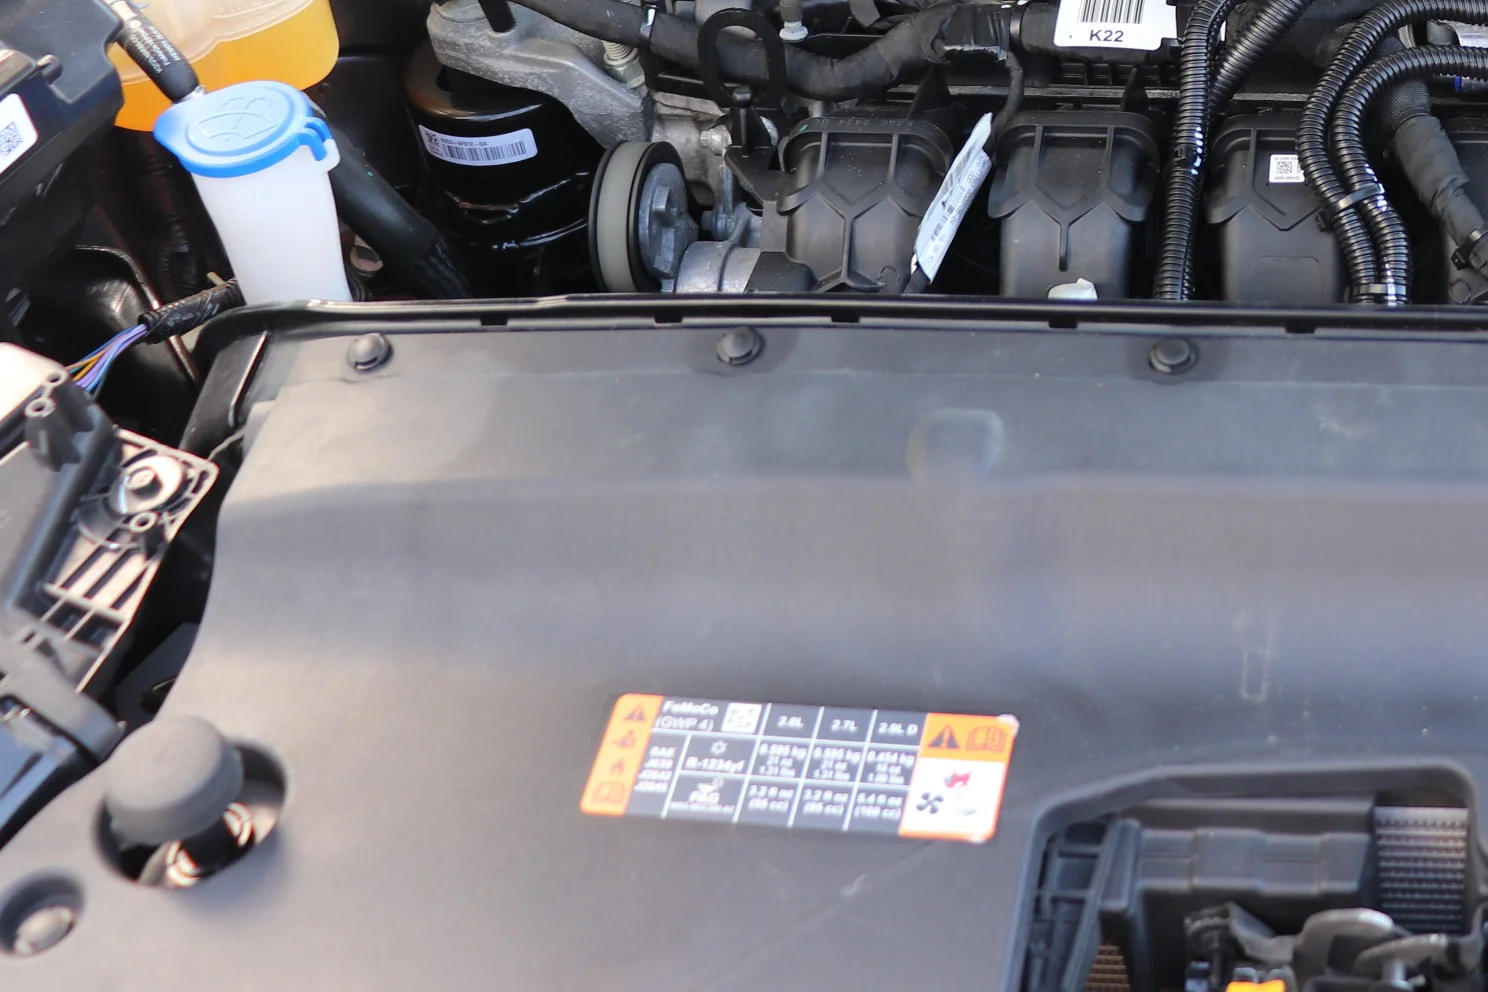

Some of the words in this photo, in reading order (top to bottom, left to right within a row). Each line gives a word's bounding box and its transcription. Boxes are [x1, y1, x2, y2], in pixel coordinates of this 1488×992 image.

[1089, 29, 1124, 42] K22
[663, 700, 719, 715] FoMoCo
[655, 715, 697, 729] (GWP
[698, 718, 714, 732] 4)
[831, 719, 858, 732] 2.7L
[906, 724, 918, 736] D
[649, 746, 676, 758] SAE
[791, 745, 808, 760] kg
[845, 749, 862, 764] kg
[685, 756, 745, 773] R-1234yf
[780, 758, 793, 767] oz
[899, 752, 915, 767] kg
[834, 761, 847, 771] oz
[889, 765, 902, 774] oz
[778, 789, 794, 799] oz
[833, 793, 849, 803] oz
[887, 797, 903, 807] oz
